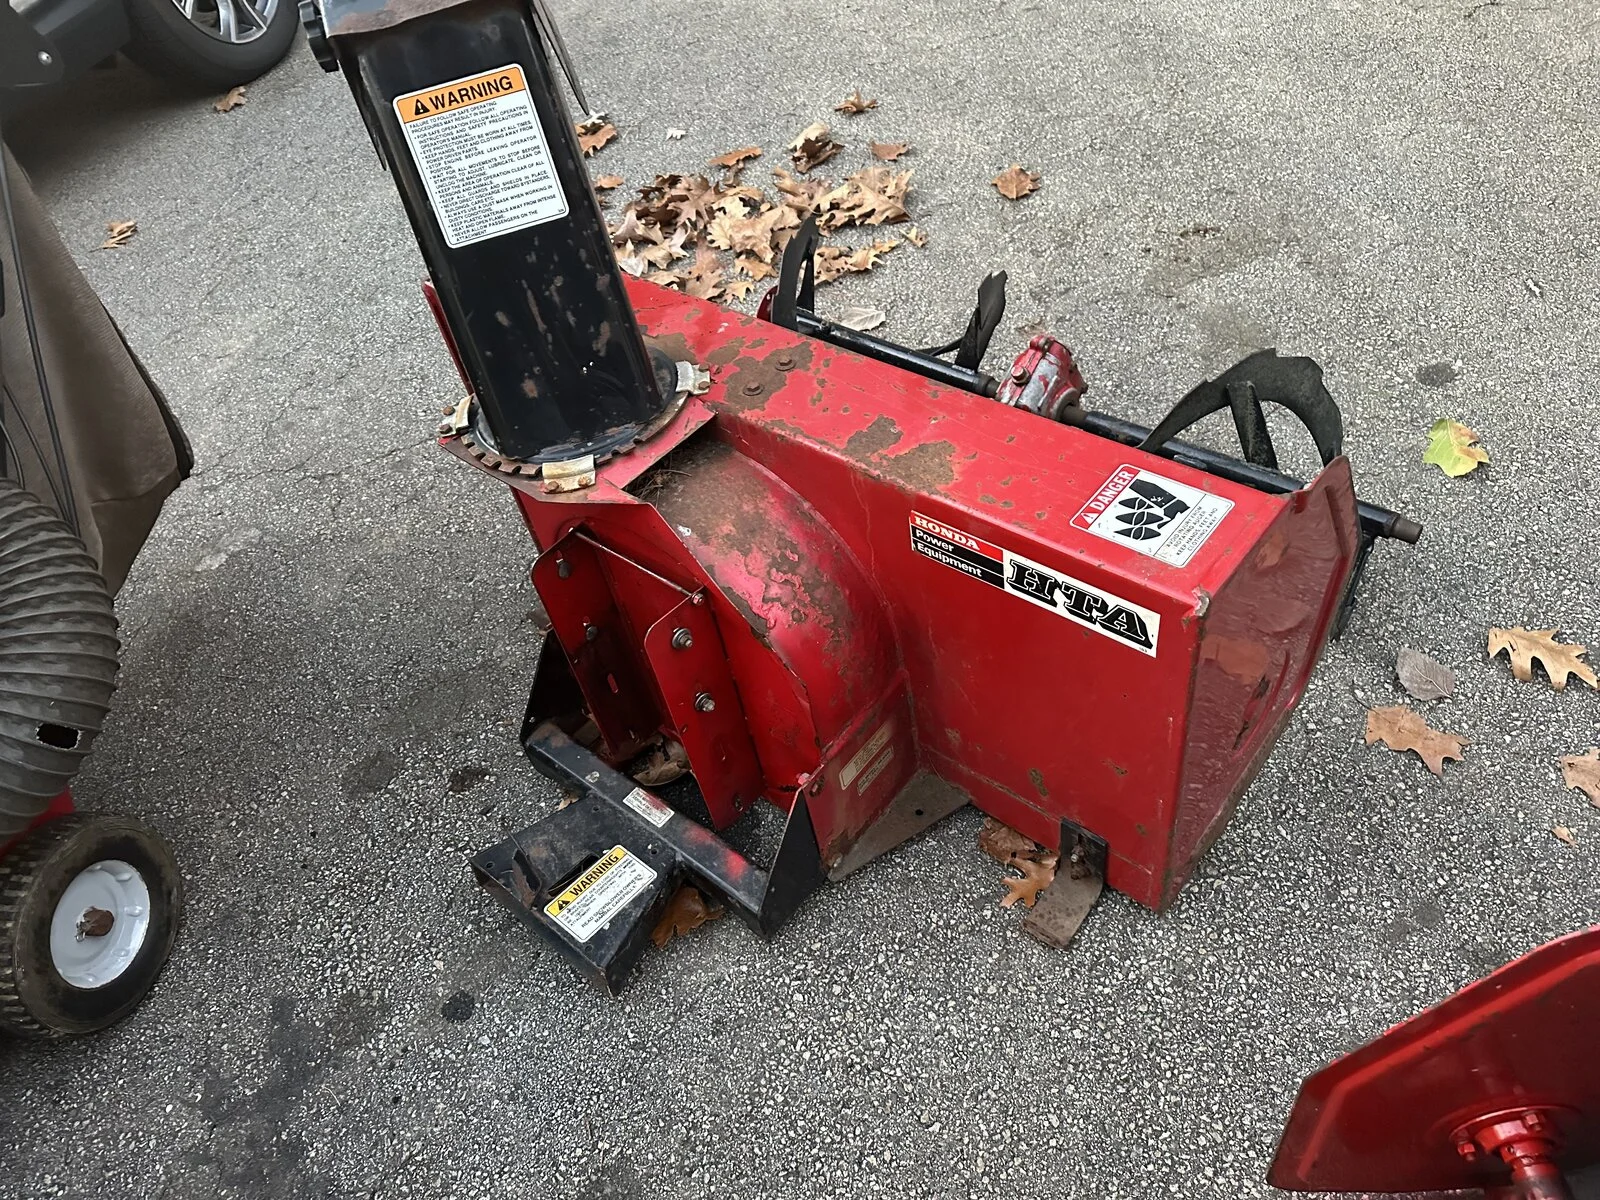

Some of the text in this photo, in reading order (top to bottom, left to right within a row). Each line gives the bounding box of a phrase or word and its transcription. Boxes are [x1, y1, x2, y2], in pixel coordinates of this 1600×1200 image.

[429, 76, 513, 110] WARNING
[409, 120, 429, 129] FAILURE
[437, 112, 457, 121] FOLLOW
[470, 101, 497, 112] OPERATING
[411, 122, 444, 134] PROCEDURES
[454, 113, 473, 122] RESULT
[441, 121, 469, 132] OPERATION
[469, 116, 489, 124] FOLLOW
[500, 105, 527, 116] OPERATING
[418, 131, 454, 144] INSTRUCTIONS
[468, 122, 487, 130] SAFETY
[488, 112, 522, 124] PRECAUTIONS
[480, 133, 504, 144] CLOTHING
[505, 129, 519, 137] AWAY
[433, 140, 463, 151] PROTECTION
[484, 129, 500, 137] WORN
[444, 156, 462, 165] ENGINE
[464, 150, 484, 159] BEFORE
[486, 144, 508, 153] LEAVING
[510, 136, 536, 146] OPERATOR
[426, 156, 444, 164] POWER
[444, 151, 462, 159] DRIVEN
[434, 174, 457, 184] STARTING
[516, 153, 533, 161] CLEAN
[468, 157, 498, 169] MOVEMENTS
[522, 145, 540, 154] BEFORE
[435, 180, 456, 189] UNCLOG
[483, 170, 511, 181] OPERATION
[511, 165, 527, 173] CLEAR
[439, 189, 461, 199] PERSONS
[458, 196, 475, 204] DIRECT
[475, 189, 500, 199] DISCHARGE
[501, 184, 520, 192] TOWARD
[467, 187, 488, 196] GUARDS
[502, 178, 522, 186] SHIELDS
[447, 209, 467, 218] ALWAYS
[525, 186, 547, 196] WORKING
[463, 215, 482, 224] PLASTIC
[483, 208, 509, 218] MATERIALS
[537, 195, 556, 203] INTENSE
[448, 215, 464, 223] DUSTY
[470, 224, 488, 232] ALLOW
[488, 215, 520, 227] PASSENGERS
[456, 229, 487, 241] ATTACHMENT
[1091, 471, 1135, 511] DANGER
[915, 517, 980, 550] HONDA
[1166, 534, 1179, 547] AVOID
[1190, 506, 1202, 518] FROM
[1174, 525, 1194, 547] ROTATING
[1176, 544, 1188, 555] KEEP
[1199, 517, 1210, 527] FEET
[1208, 508, 1218, 516] AND
[916, 529, 954, 552] Power
[1188, 529, 1208, 551] CLOTHING
[918, 543, 982, 577] Equipment
[1006, 559, 1153, 649] HTA
[570, 855, 619, 895] WARNING
[581, 916, 594, 928] READ
